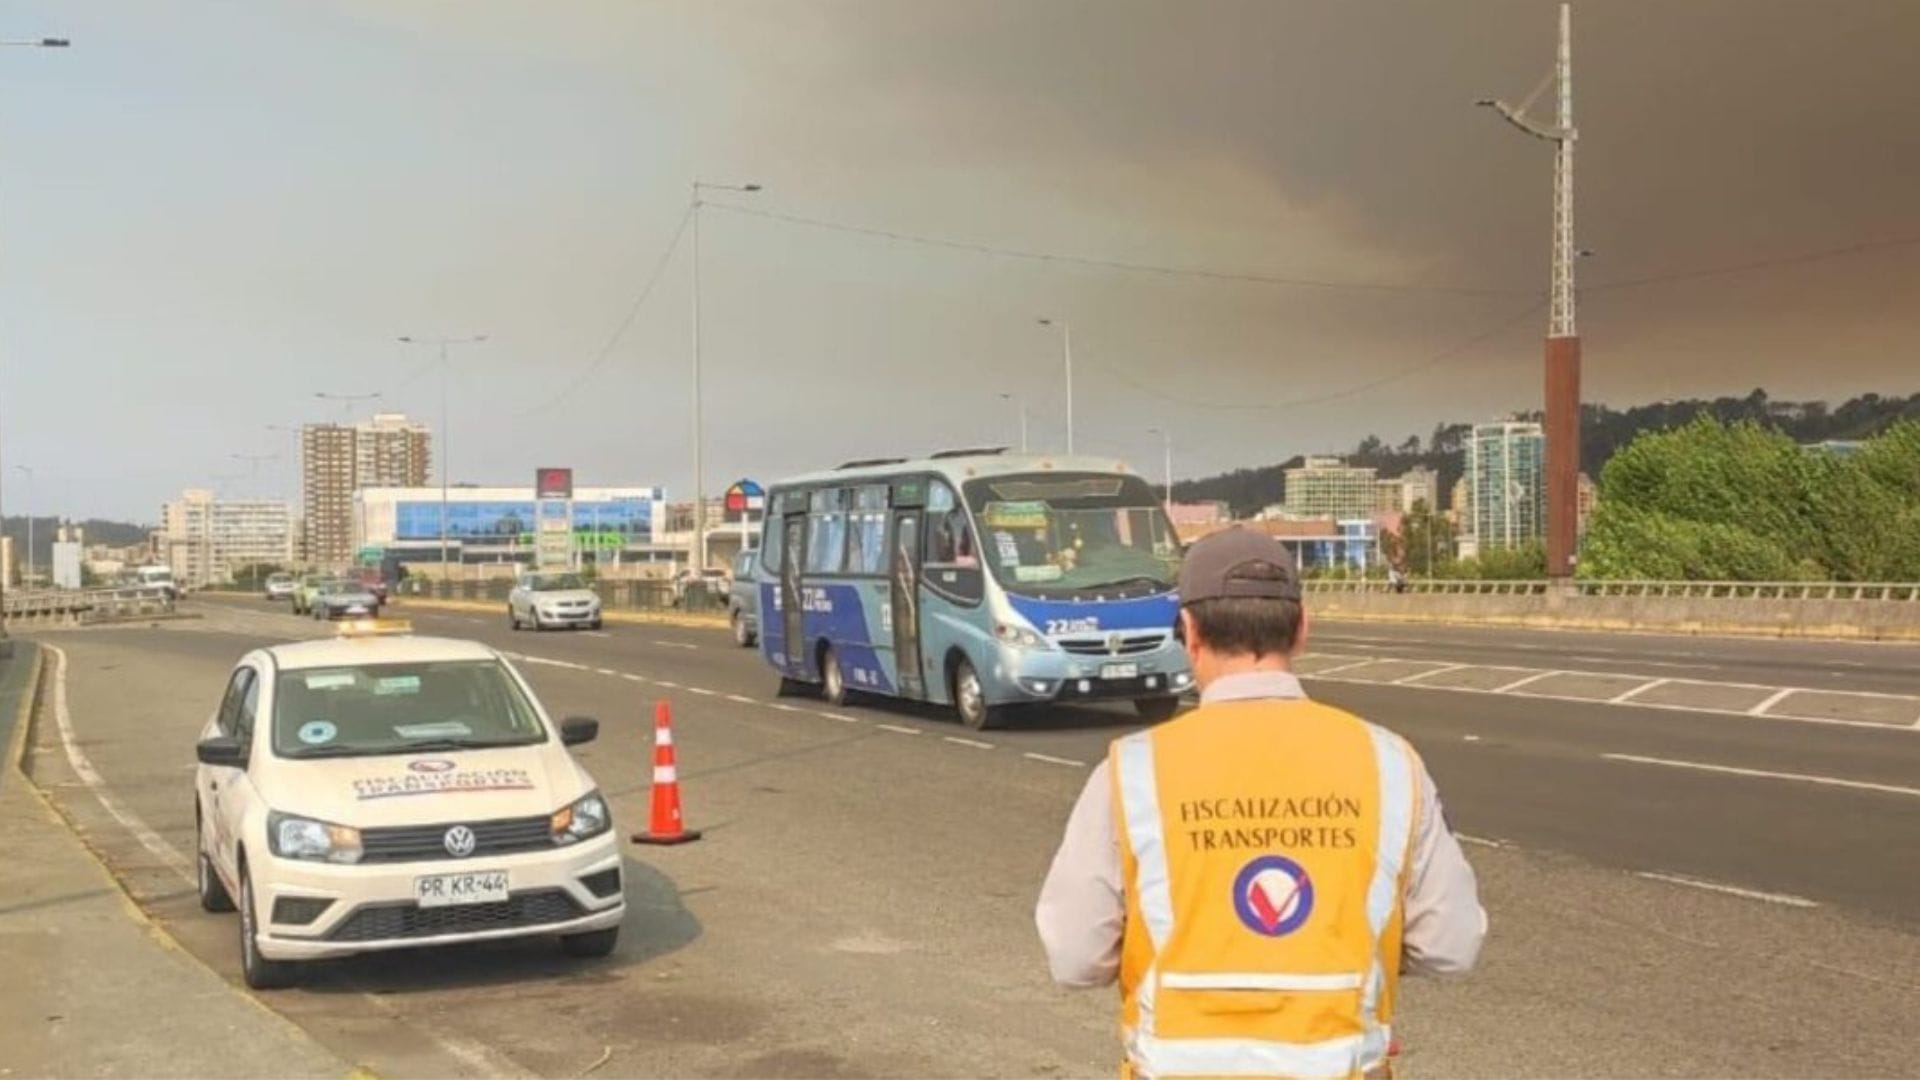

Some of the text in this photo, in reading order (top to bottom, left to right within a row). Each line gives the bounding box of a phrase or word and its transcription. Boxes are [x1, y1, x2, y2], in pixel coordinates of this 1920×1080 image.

[1045, 619, 1068, 634] 22
[356, 777, 533, 796] TRANSPORTES
[1181, 791, 1360, 822] FISCALIZACIÓN
[1189, 827, 1356, 851] TRANSPORTES
[420, 879, 443, 896] PR
